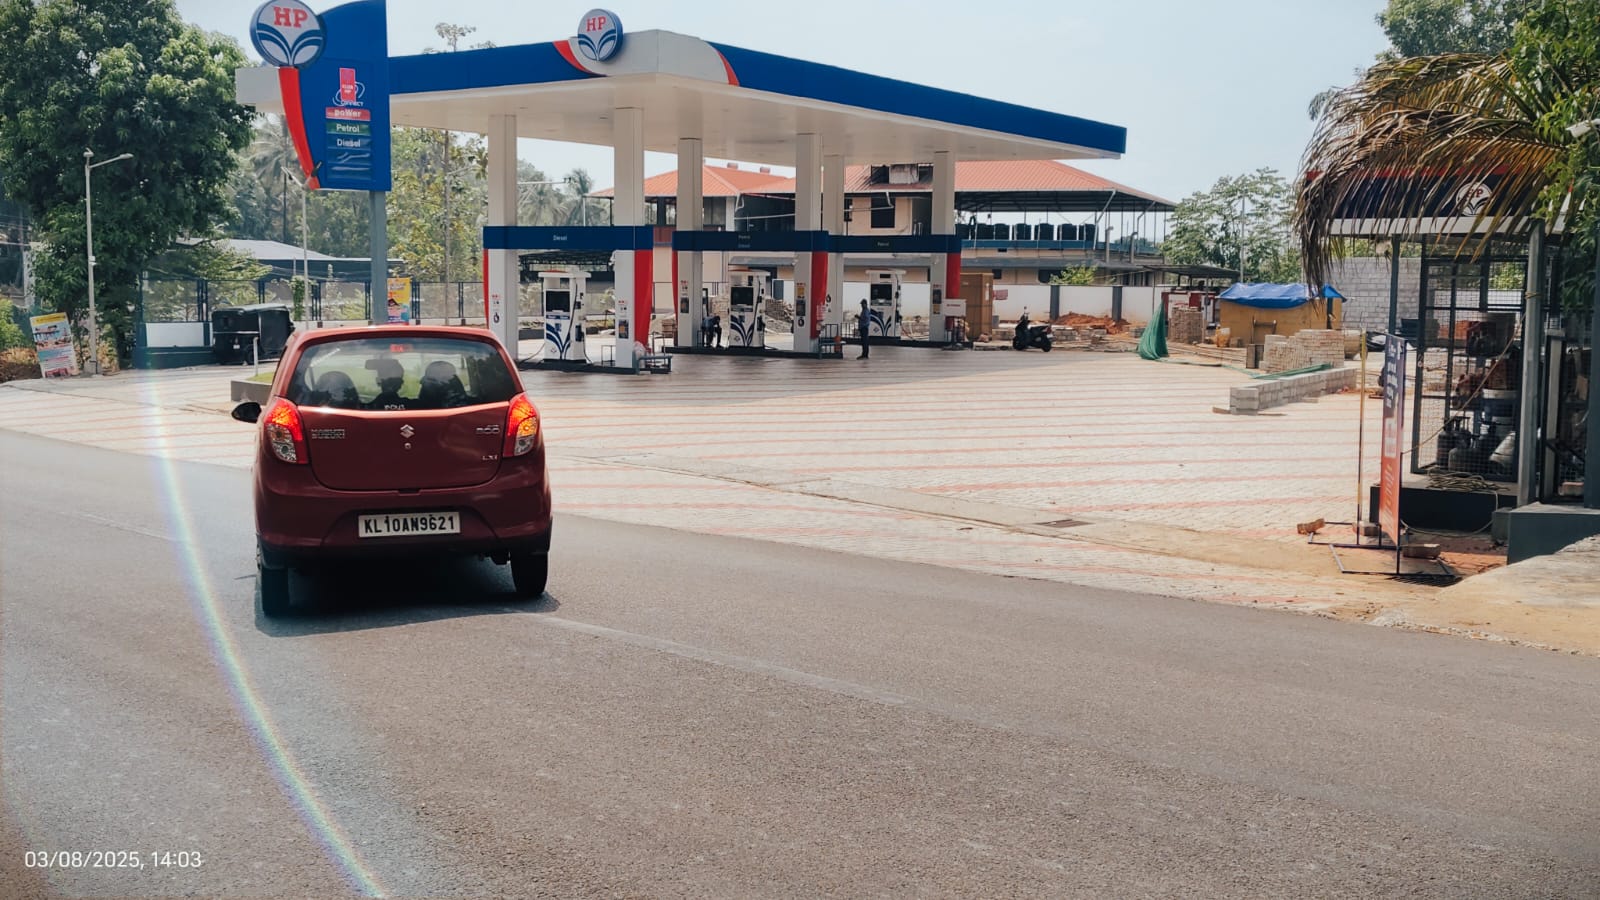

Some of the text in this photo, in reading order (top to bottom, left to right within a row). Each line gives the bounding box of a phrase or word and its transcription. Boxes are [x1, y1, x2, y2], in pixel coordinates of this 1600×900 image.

[273, 6, 308, 28] HP
[586, 16, 607, 32] HP
[336, 123, 360, 133] Petrol
[336, 138, 361, 148] Diesel
[364, 515, 454, 534] KL10AN9621
